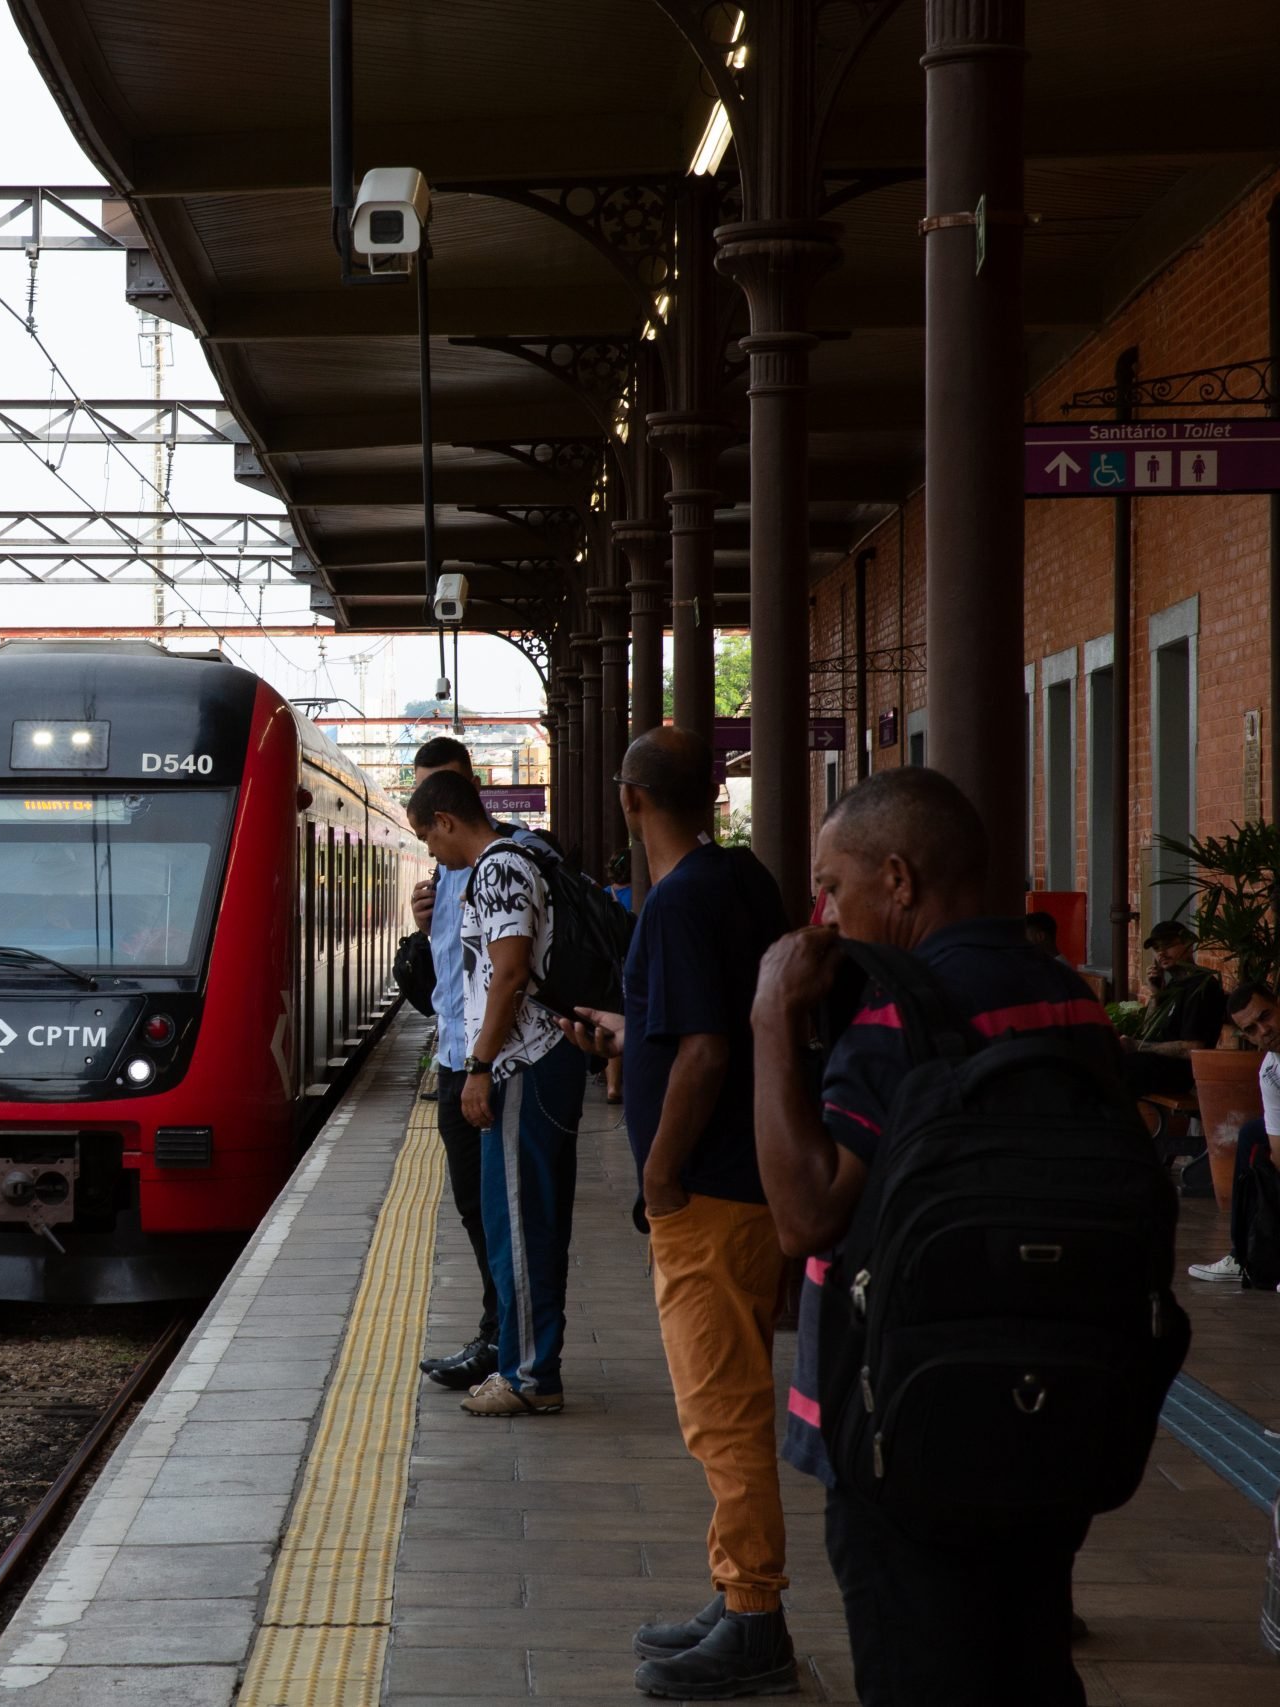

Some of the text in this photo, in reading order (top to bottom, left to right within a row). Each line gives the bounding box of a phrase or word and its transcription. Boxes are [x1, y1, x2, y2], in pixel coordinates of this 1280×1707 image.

[1089, 424, 1167, 440] Sanitário
[1183, 423, 1232, 438] Toilet
[141, 752, 213, 775] D540
[485, 799, 531, 809] da Serra
[27, 1025, 107, 1048] CPTM
